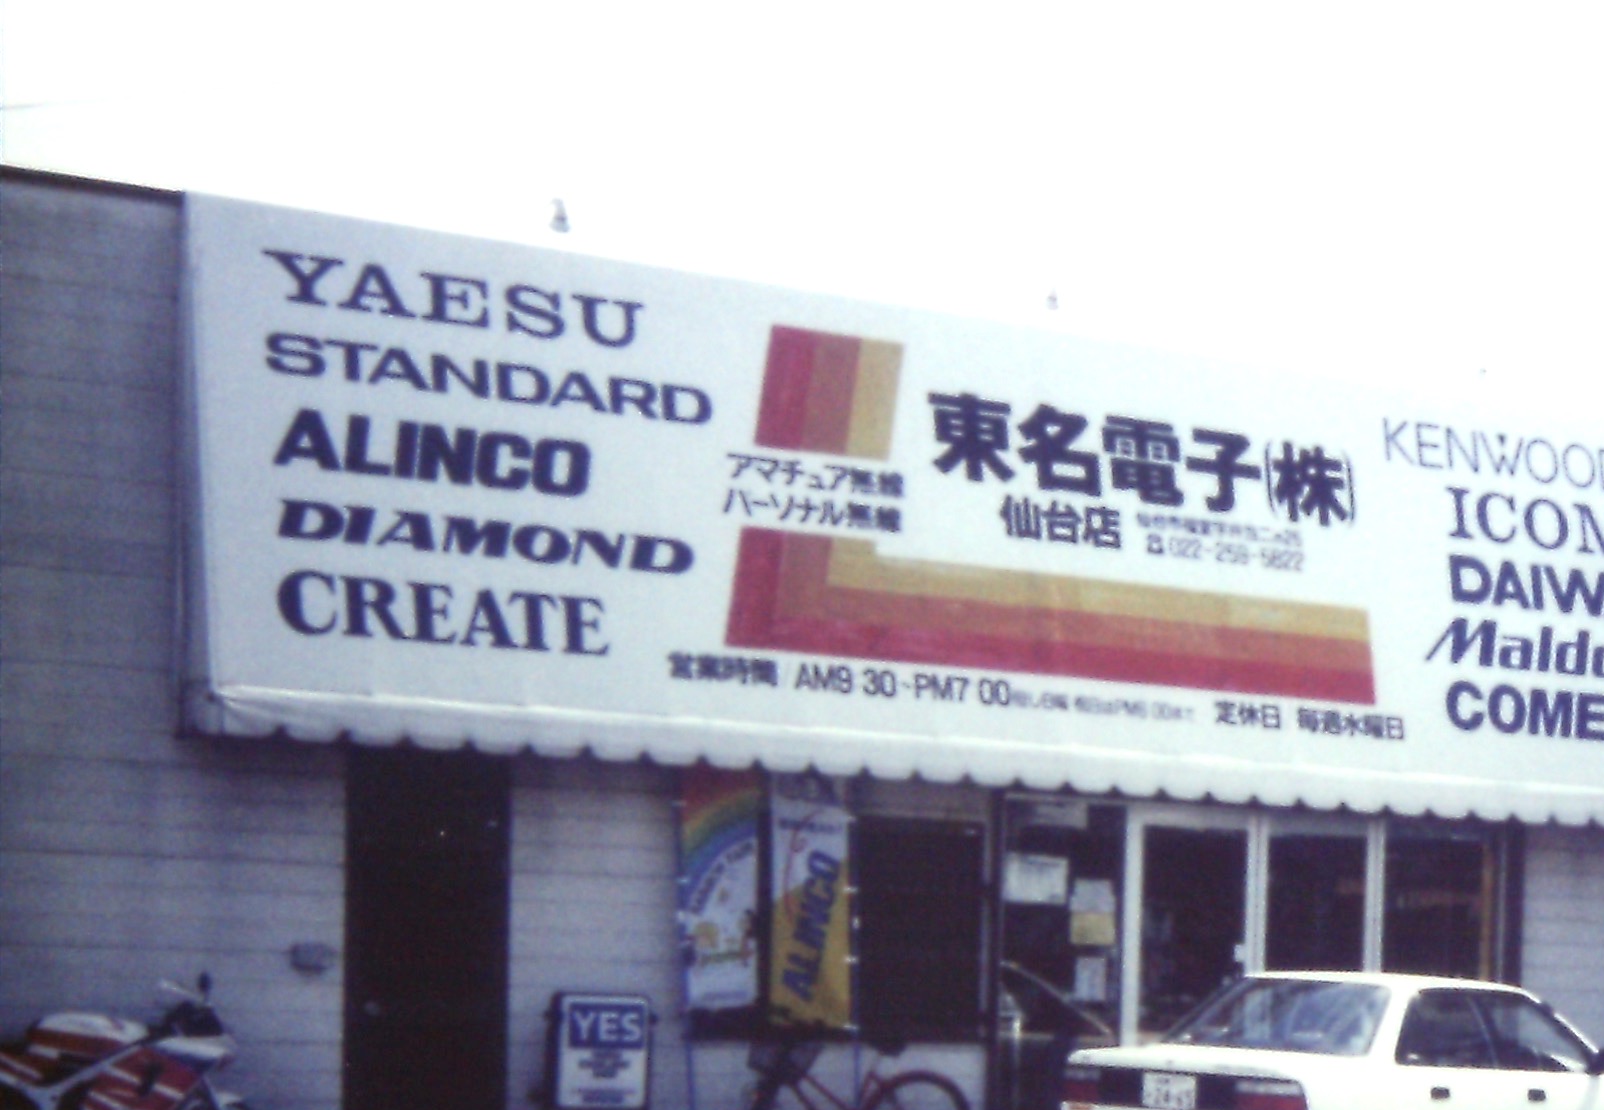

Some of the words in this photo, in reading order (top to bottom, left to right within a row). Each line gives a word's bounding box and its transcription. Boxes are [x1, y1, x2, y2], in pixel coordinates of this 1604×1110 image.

[262, 249, 643, 348] YAESU
[266, 332, 712, 424] STANDARD
[274, 409, 591, 496] ALINCO
[278, 499, 693, 574] DIAMOND
[1000, 495, 1121, 549] 仙台店
[277, 570, 608, 656] CREATE
[1215, 700, 1281, 730] 定休日
[781, 849, 843, 1002] ALINCO
[572, 1011, 642, 1043] YES
